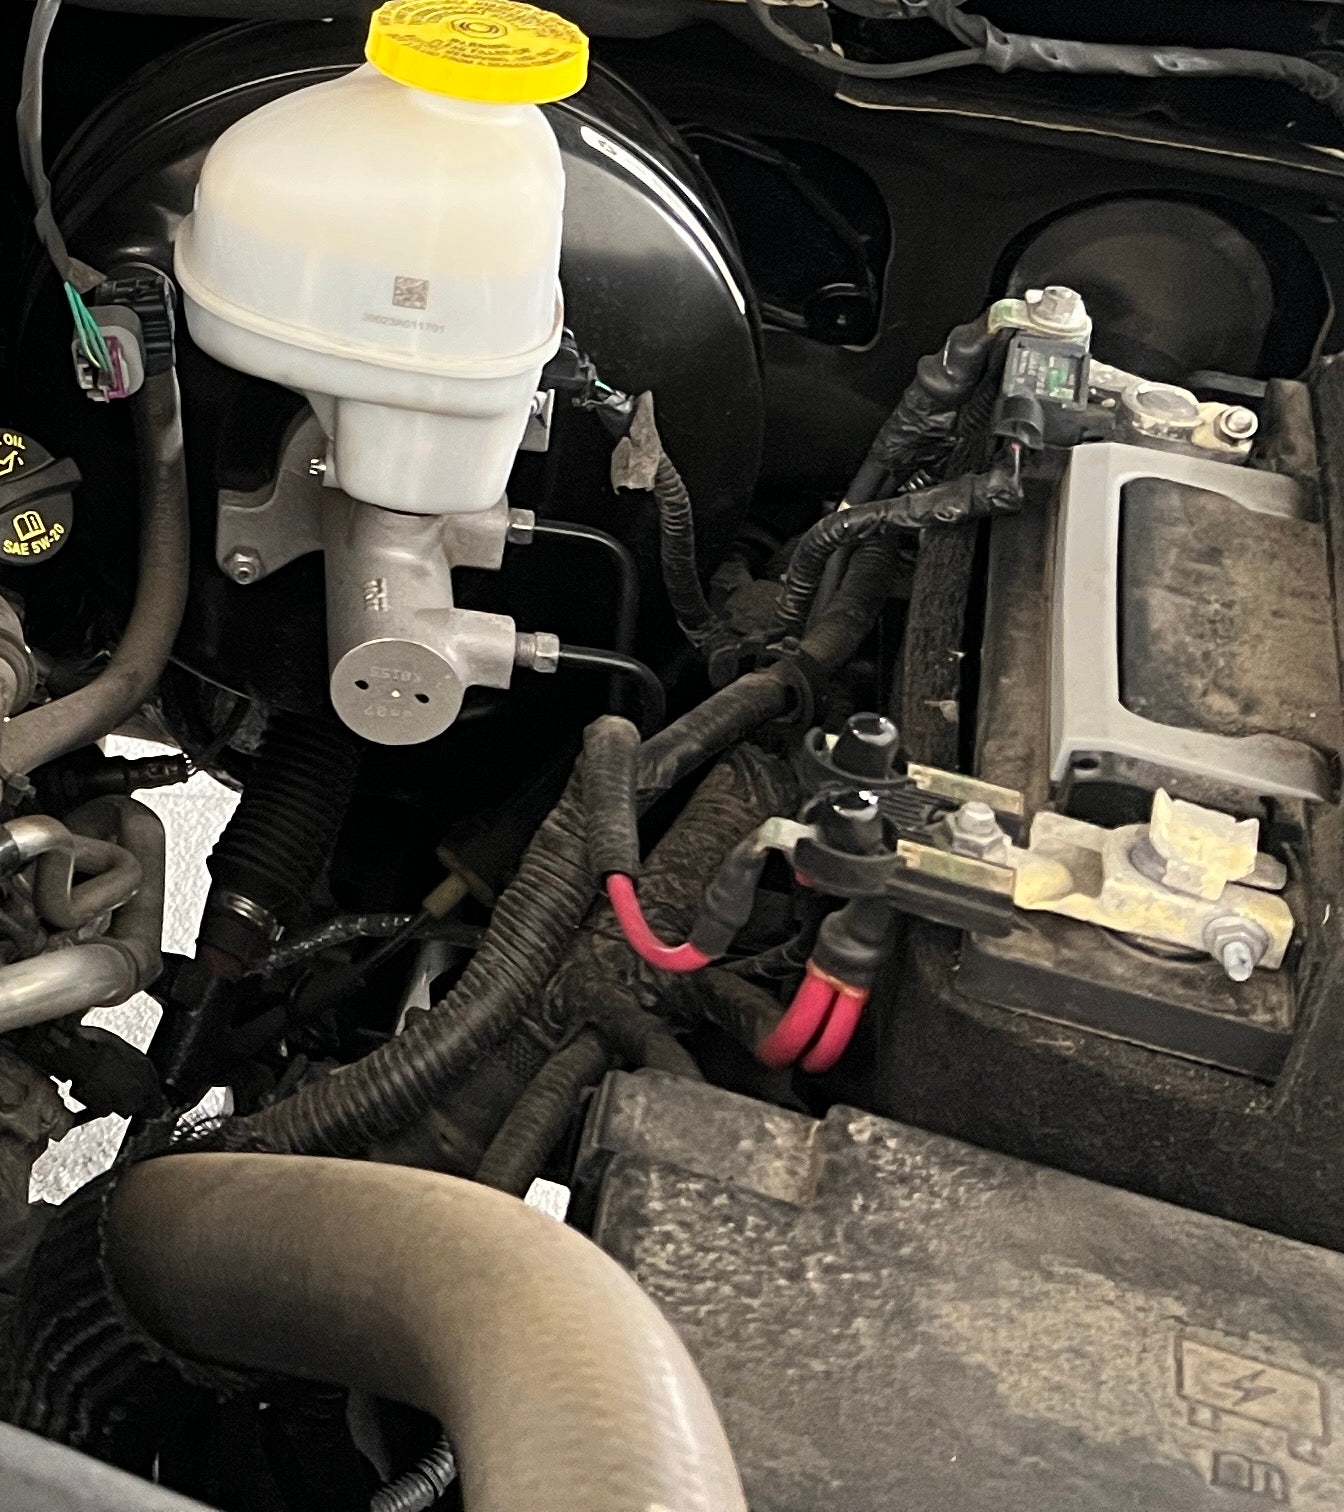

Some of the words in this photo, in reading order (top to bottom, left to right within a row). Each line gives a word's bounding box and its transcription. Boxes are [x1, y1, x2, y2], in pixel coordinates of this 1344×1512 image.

[3, 433, 26, 449] OIL
[3, 540, 30, 556] SAE
[31, 523, 65, 554] 5W-20
